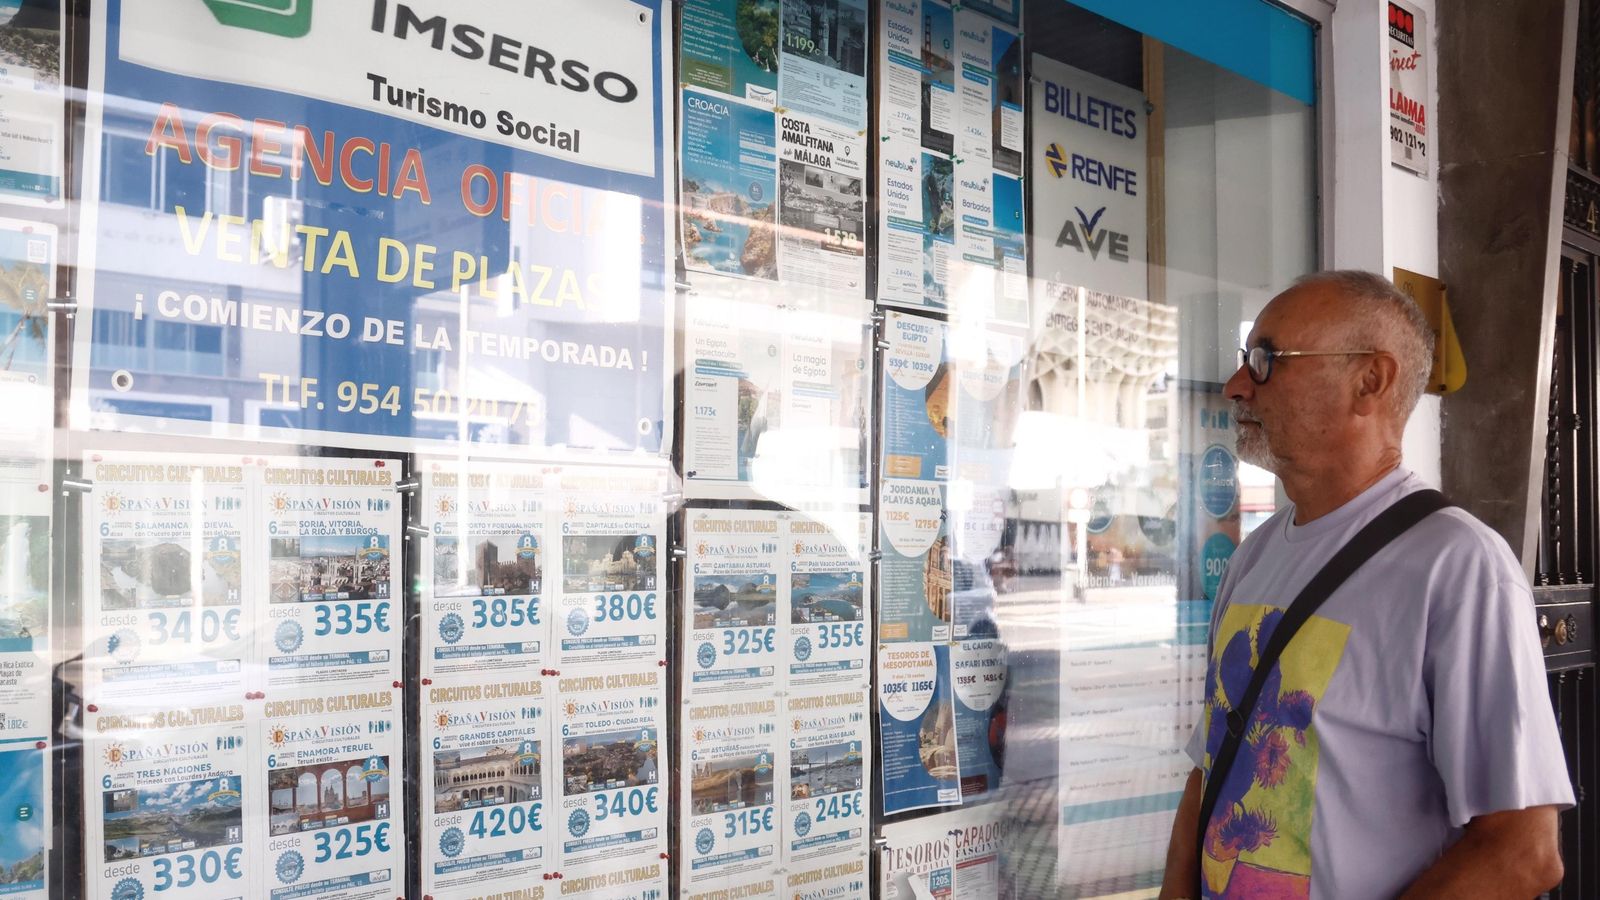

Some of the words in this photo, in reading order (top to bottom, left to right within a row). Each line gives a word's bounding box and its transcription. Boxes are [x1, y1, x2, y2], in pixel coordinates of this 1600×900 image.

[887, 20, 913, 36] Estados
[1389, 26, 1414, 46] ECURITAS
[887, 30, 910, 45] Unidos
[371, 0, 638, 103] IMSERSO
[1390, 50, 1422, 73] irect
[367, 72, 487, 130] Turismo
[496, 110, 580, 153] Social
[687, 97, 730, 117] CROACIA
[1045, 80, 1137, 140] BILLETES
[781, 116, 811, 135] COSTA
[781, 130, 834, 154] AMALFITANA
[1390, 125, 1403, 144] 902
[1404, 131, 1417, 150] 121
[145, 102, 431, 205] AGENCIA
[793, 147, 832, 169] MÁLAGA
[1071, 152, 1137, 197] RENFE
[887, 177, 913, 192] Estados
[887, 188, 910, 202] Unidos
[961, 198, 992, 214] Barbados
[1055, 206, 1129, 263] AVE
[175, 205, 360, 278] VENTA
[377, 237, 437, 290] DE
[451, 250, 606, 311] PLAZAS
[157, 290, 350, 338] COMIENZO
[363, 317, 405, 346] DE
[415, 324, 451, 351] LA
[465, 330, 633, 371] TEMPORADA
[792, 353, 802, 362] La
[803, 354, 827, 367] magia
[792, 366, 801, 374] de
[803, 367, 827, 377] Egipto
[259, 372, 324, 410] TLF.
[337, 381, 401, 417] 954
[264, 468, 324, 485] CIRCUITOS
[327, 469, 392, 486] CULTURALES
[889, 485, 930, 495] JORDANIA
[930, 487, 936, 496] Y
[882, 495, 914, 505] PLAYAS
[915, 497, 941, 507] AQABA
[100, 522, 110, 537] 6
[268, 521, 278, 535] 6
[299, 521, 327, 529] SORIA,
[329, 521, 364, 529] VITORIA,
[299, 528, 310, 536] LA
[311, 528, 337, 536] RIOJA
[345, 527, 378, 536] BURGOS
[433, 521, 442, 534] 6
[562, 522, 569, 534] 6
[694, 563, 700, 574] 6
[791, 561, 797, 572] 6
[269, 606, 300, 618] desde
[434, 602, 462, 611] desde
[472, 597, 541, 629] 385€
[594, 593, 656, 622] 380€
[101, 614, 137, 626] desde
[148, 608, 242, 645] 340€
[314, 602, 390, 636] 335€
[693, 632, 714, 641] desde
[723, 628, 776, 655] 325€
[818, 622, 864, 649] 355€
[962, 641, 971, 651] EL
[972, 641, 993, 650] CAIRO
[887, 651, 919, 660] TESOROS
[921, 650, 930, 658] DE
[882, 659, 934, 670] MESOPOTAMIA
[558, 676, 604, 693] CIRCUITOS
[606, 671, 658, 689] CULTURALES
[882, 682, 908, 694] 1035€
[911, 680, 934, 692] 1165€
[430, 685, 481, 703] CIRCUITOS
[484, 680, 542, 699] CULTURALES
[264, 697, 324, 718] CIRCUITOS
[326, 691, 392, 712] CULTURALES
[689, 704, 729, 720] CIRCUITOS
[730, 699, 775, 716] CULTURALES
[787, 695, 825, 711] CIRCUITOS
[825, 692, 864, 708] CULTURALES
[562, 724, 569, 736] 6
[585, 719, 612, 728] TOLEDO
[615, 717, 638, 726] CIUDAD
[459, 731, 496, 741] GRANDES
[497, 727, 536, 738] CAPITALES
[297, 747, 341, 758] ENAMORA
[341, 743, 374, 754] TERUEL
[433, 737, 441, 749] 6
[711, 744, 740, 754] ASTURIAS
[790, 738, 796, 748] 6
[267, 754, 277, 768] 6
[691, 750, 698, 761] 6
[136, 769, 161, 778] TRES
[163, 763, 212, 776] NACIONES
[177, 773, 202, 781] Lourdes
[102, 775, 112, 789] 6
[563, 797, 588, 809] desde
[594, 786, 659, 821] 340€
[790, 802, 809, 812] desde
[816, 792, 863, 822] 245€
[434, 814, 462, 827] desde
[468, 803, 543, 839] 420€
[691, 818, 712, 828] desde
[724, 806, 774, 839] 315€
[269, 837, 301, 852] desde
[314, 822, 391, 864] 325€
[886, 838, 950, 872] TESOROS
[104, 863, 140, 879] desde
[153, 846, 243, 892] 330€
[787, 869, 823, 887] CIRCUITOS
[823, 860, 864, 880] CULTURALES
[560, 874, 607, 896] CIRCUITOS
[608, 864, 660, 885] CULTURALES
[730, 880, 774, 899] CULTURALES
